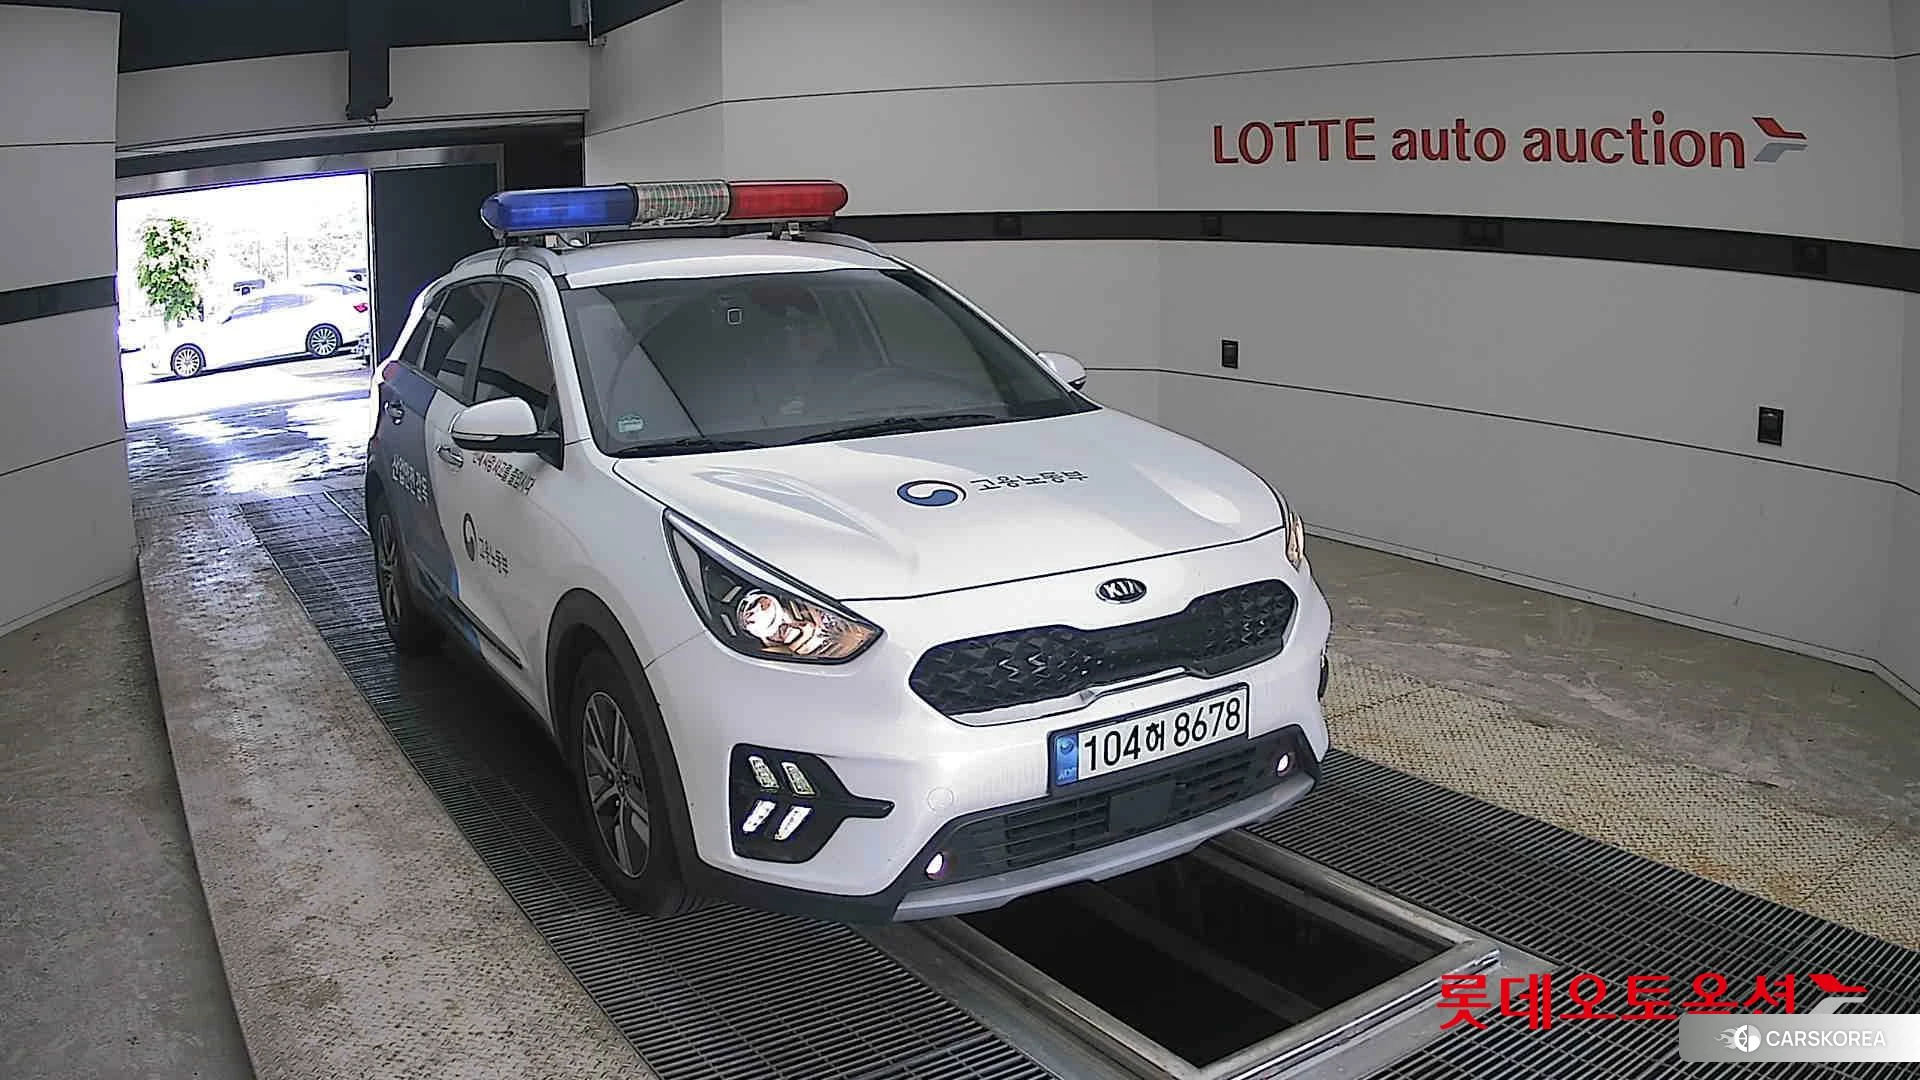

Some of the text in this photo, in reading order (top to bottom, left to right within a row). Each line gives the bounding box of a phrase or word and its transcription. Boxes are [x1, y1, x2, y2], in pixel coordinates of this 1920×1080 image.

[1213, 110, 1745, 169] LOTTE auto auction
[969, 470, 1089, 491] 고용노동부
[1102, 580, 1143, 600] KIA
[1084, 697, 1241, 771] 104허 8678
